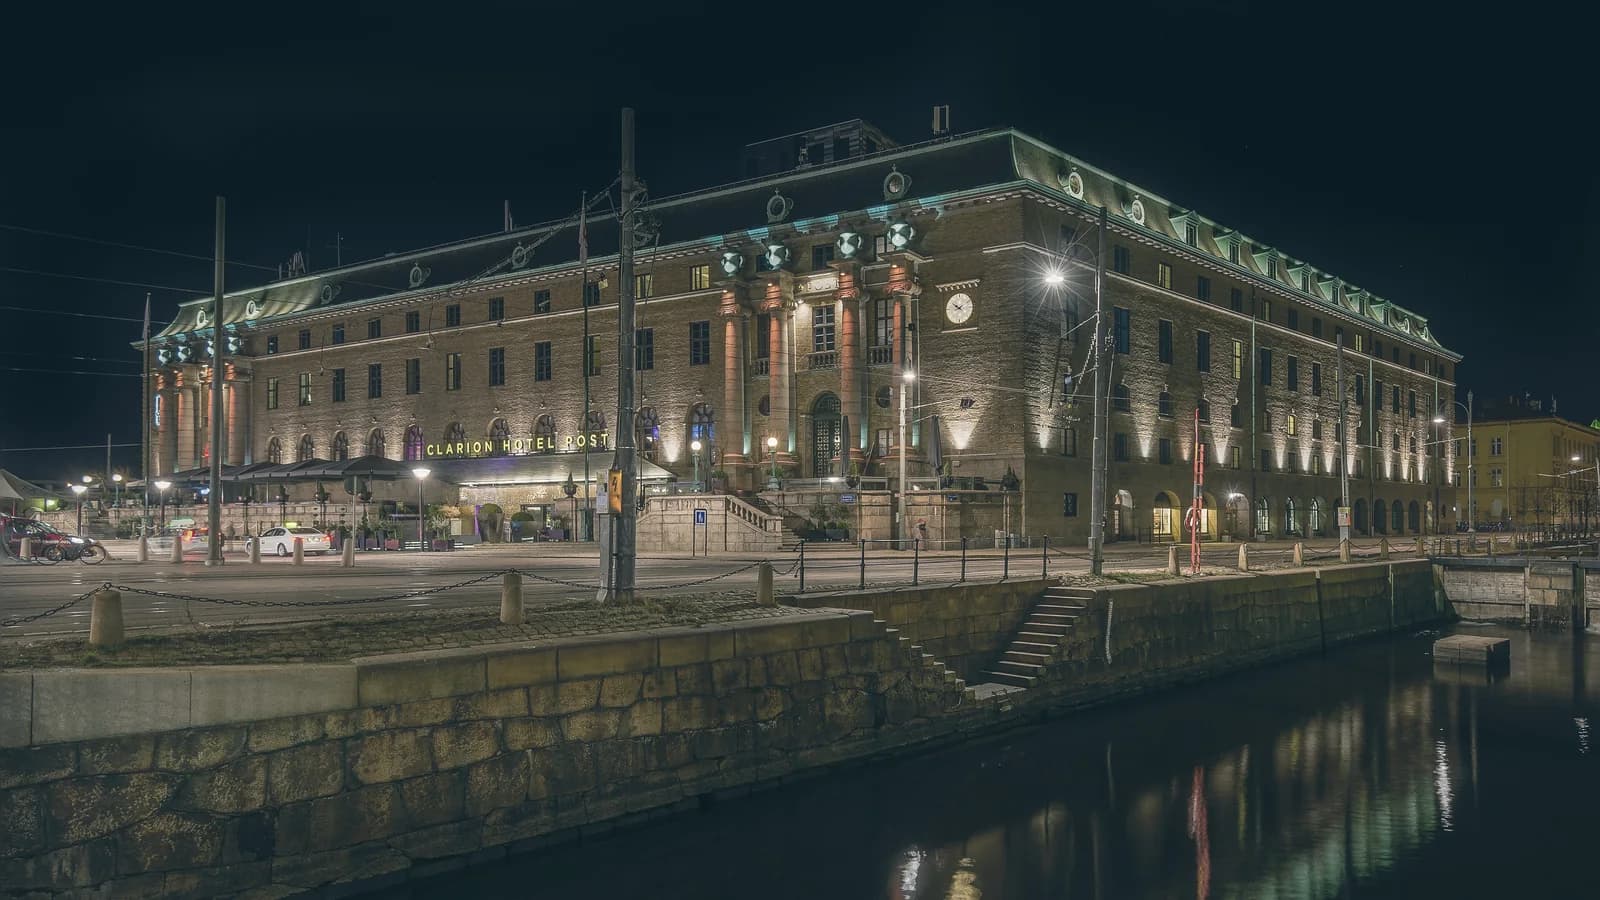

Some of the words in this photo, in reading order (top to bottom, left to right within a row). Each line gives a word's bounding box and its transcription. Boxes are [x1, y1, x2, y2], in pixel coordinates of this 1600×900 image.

[427, 440, 492, 455] CLARION
[503, 437, 554, 451] HOTEL
[566, 433, 608, 448] POST
